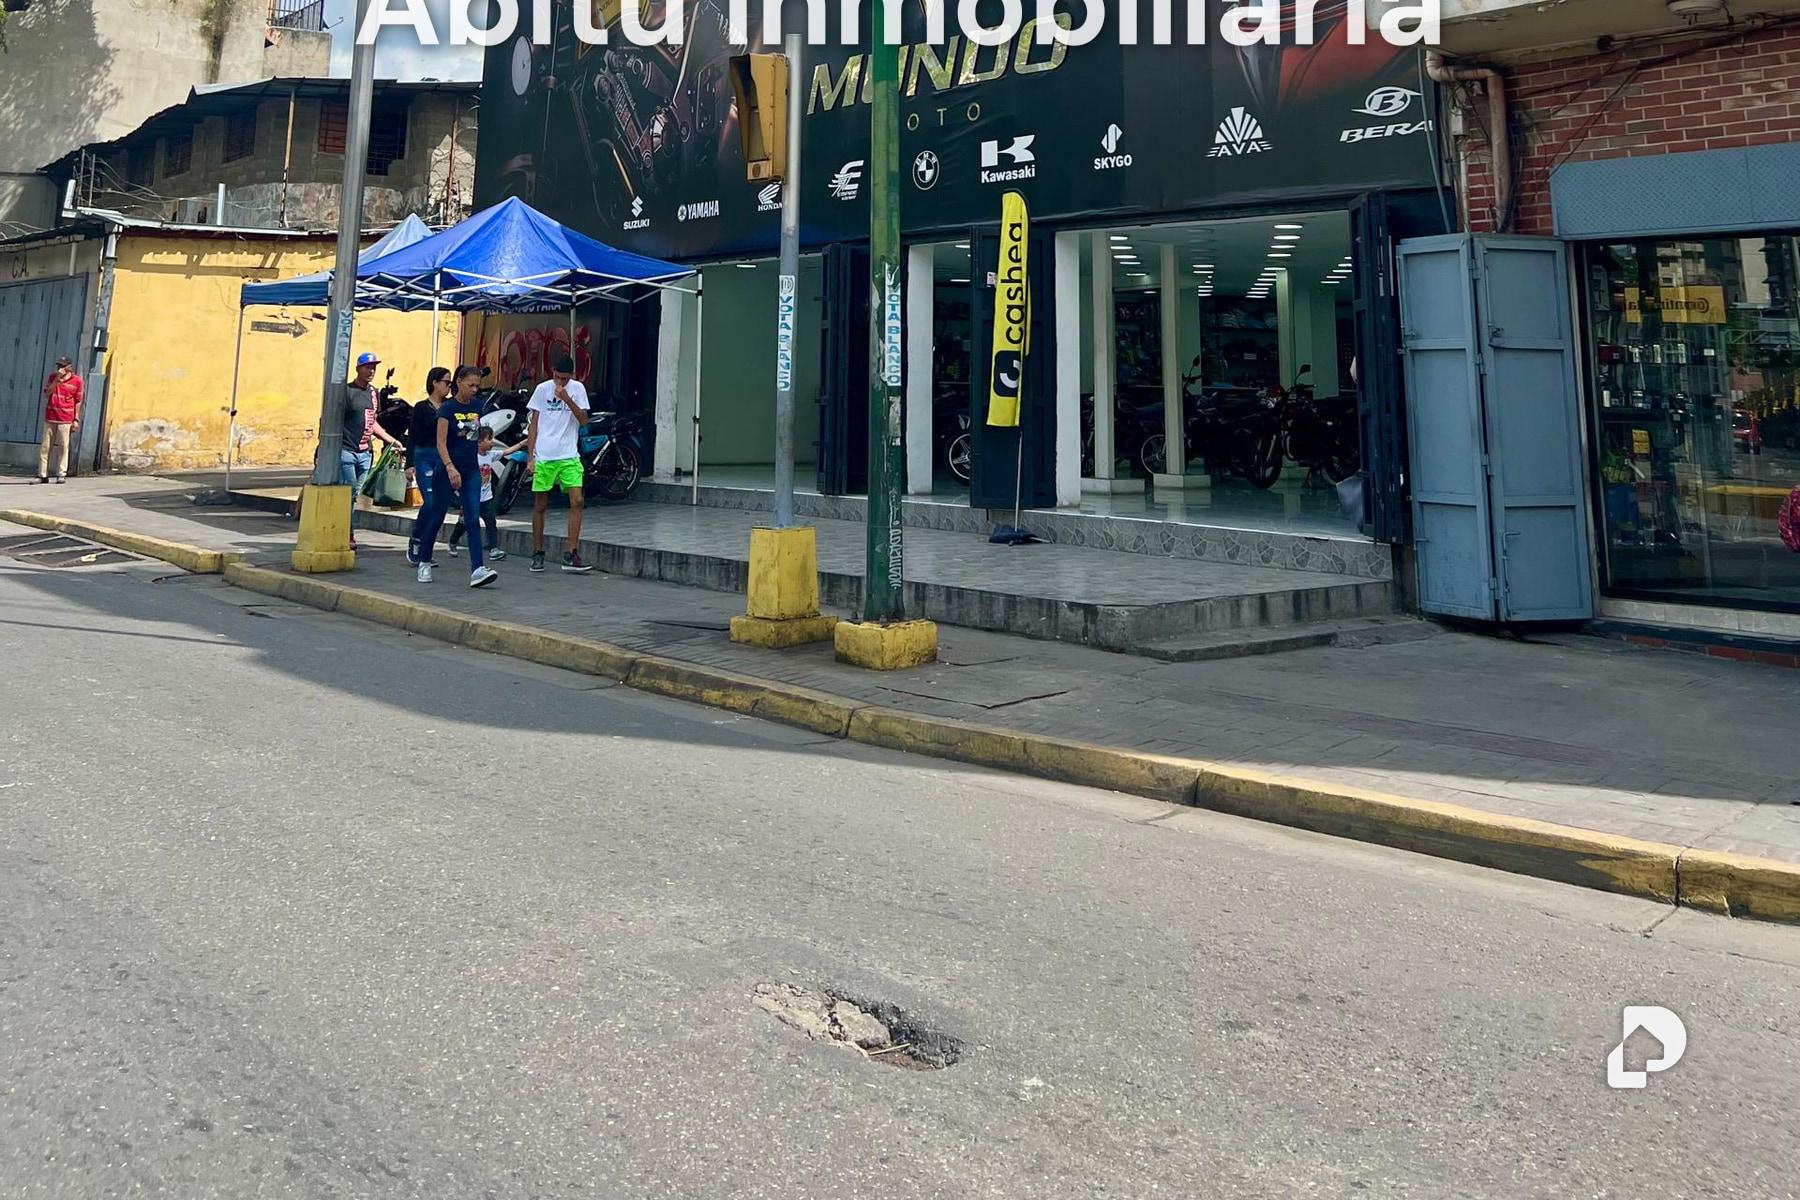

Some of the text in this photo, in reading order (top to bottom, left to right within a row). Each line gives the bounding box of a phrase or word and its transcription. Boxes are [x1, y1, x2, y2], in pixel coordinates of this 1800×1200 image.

[1339, 119, 1434, 143] BERA
[1217, 141, 1262, 158] AVA
[1093, 154, 1133, 170] SKYGO
[980, 165, 1036, 184] Kawasaki
[687, 200, 720, 220] YAMAHA
[757, 202, 783, 212] HONDA
[623, 218, 650, 230] SUZUKI
[1000, 222, 1026, 345] cashea
[886, 325, 901, 384] BLANCO
